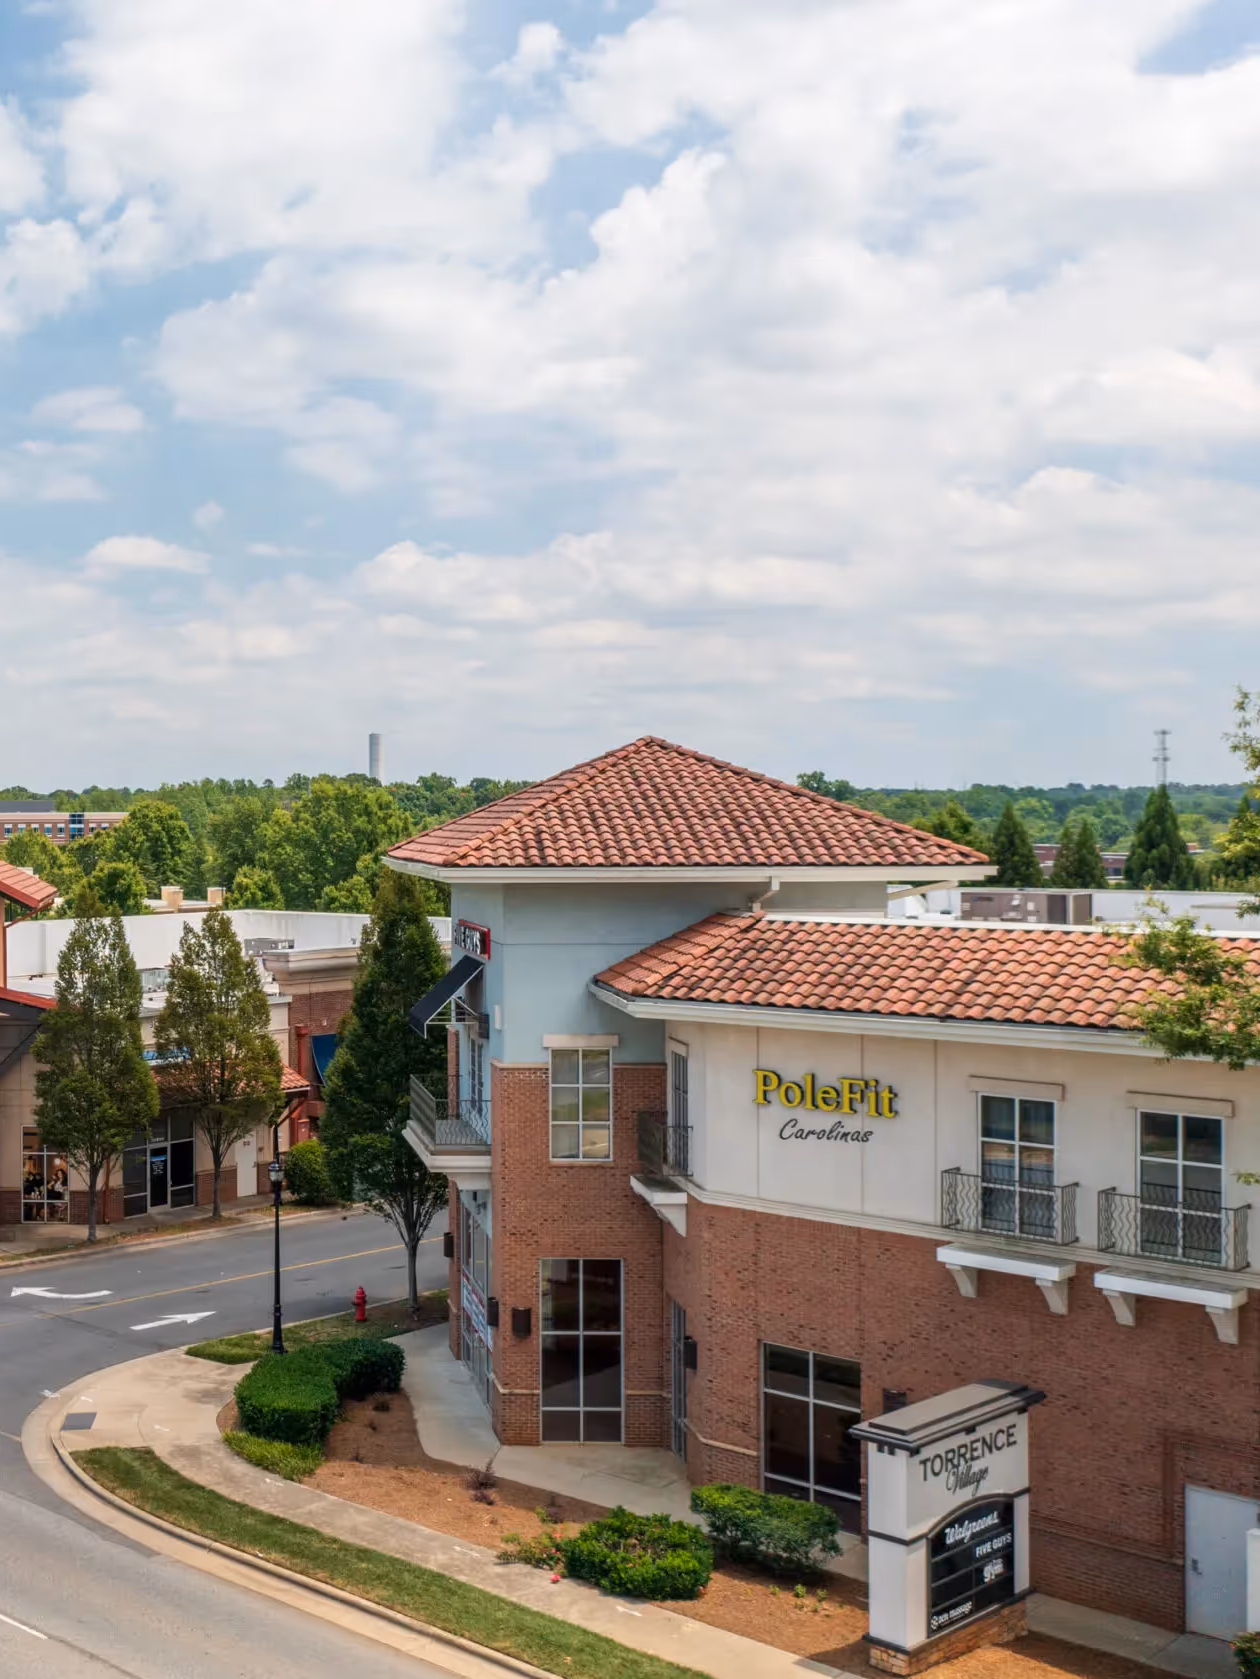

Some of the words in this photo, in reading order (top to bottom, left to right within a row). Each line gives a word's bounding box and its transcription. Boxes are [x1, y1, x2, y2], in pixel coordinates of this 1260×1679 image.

[752, 1069, 899, 1118] PoleFit
[778, 1118, 874, 1143] Carolinas
[919, 1424, 1018, 1482] TORRENCE
[945, 1464, 989, 1496] Village
[944, 1511, 1000, 1545] Walgreens
[975, 1541, 992, 1558] FIVE
[992, 1532, 1012, 1550] GUYS
